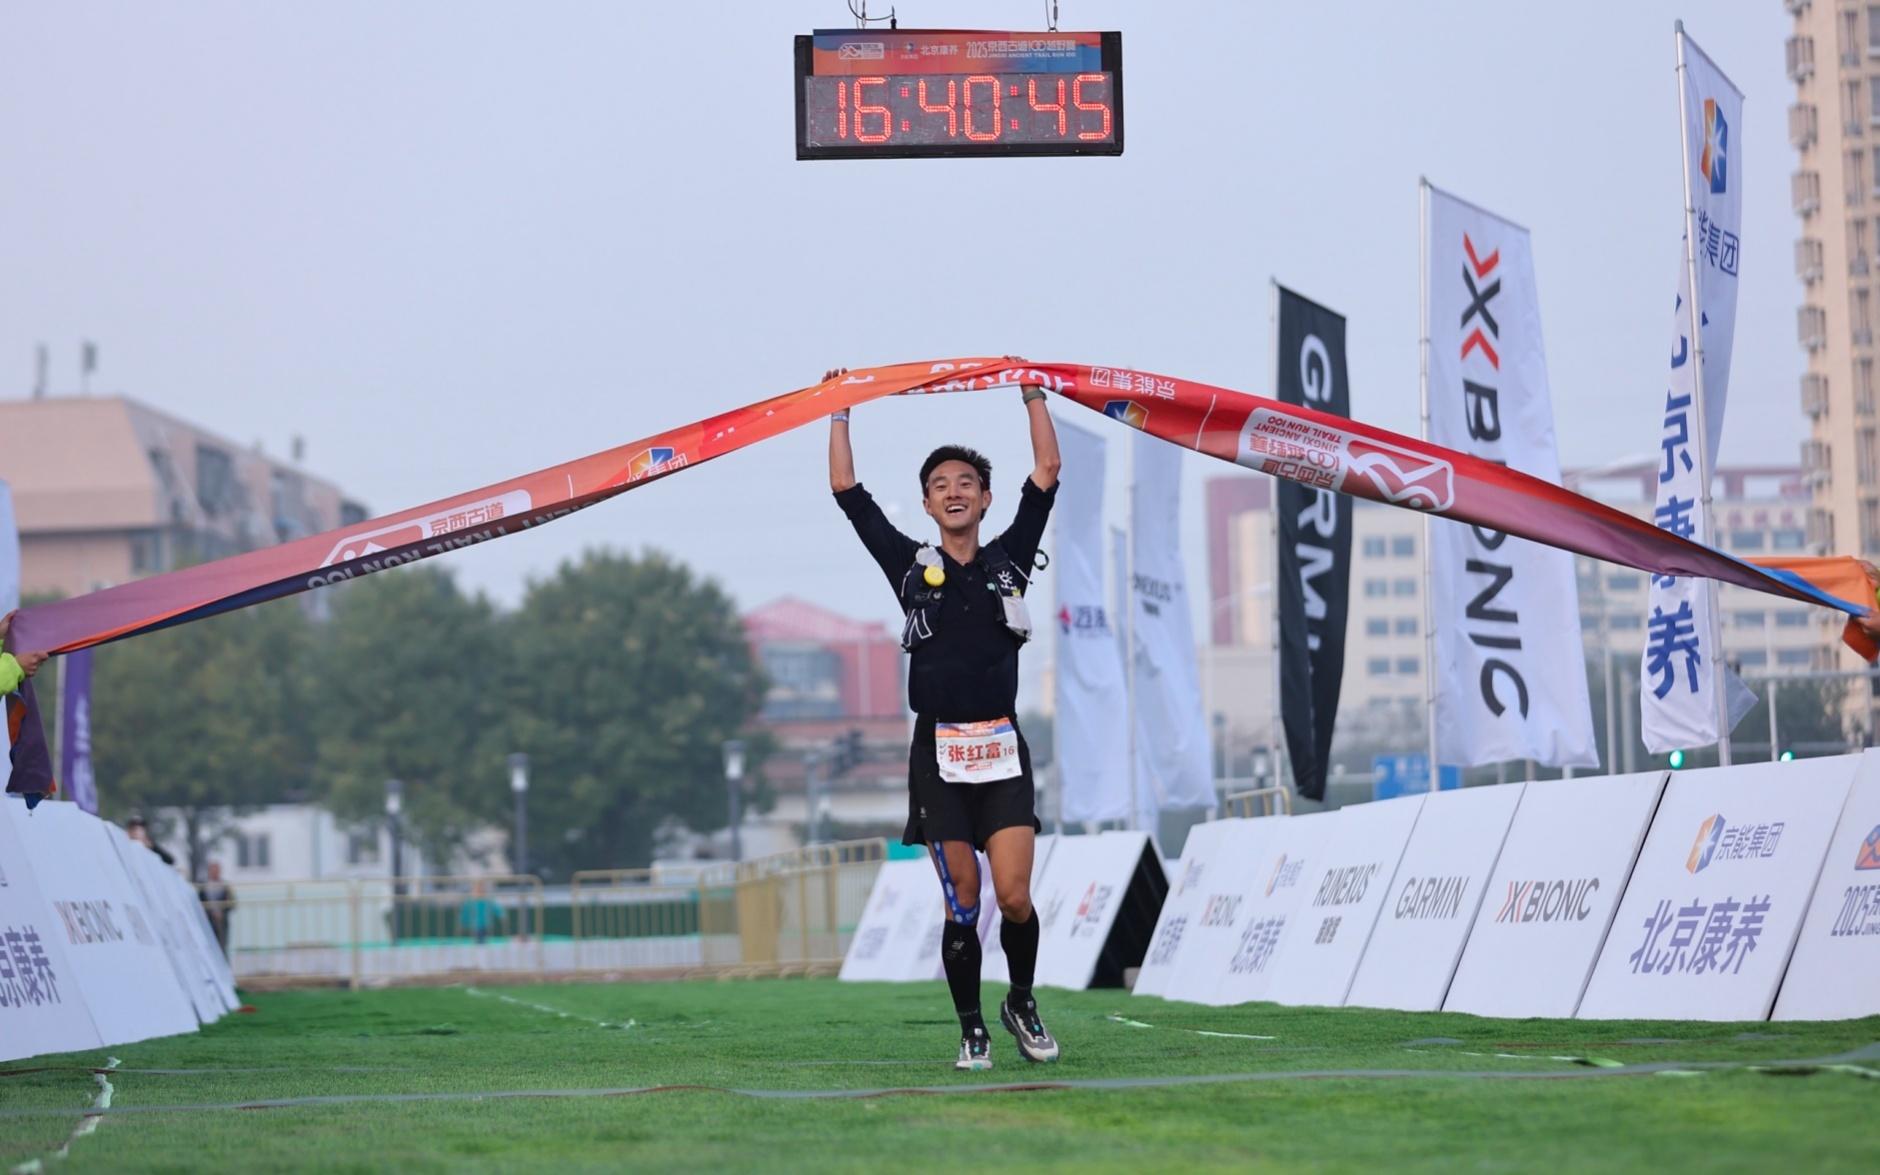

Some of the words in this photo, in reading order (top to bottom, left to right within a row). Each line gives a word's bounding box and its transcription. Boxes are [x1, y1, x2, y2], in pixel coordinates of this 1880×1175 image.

[837, 74, 1110, 142] 16:40:45
[1089, 366, 1176, 399] 京能集团
[1253, 423, 1302, 441] ANCIENT
[1267, 415, 1287, 427] 100
[1287, 420, 1311, 434] RUN
[1302, 436, 1339, 452] JINGXI
[1310, 427, 1342, 443] TRAIL
[1715, 822, 1785, 861] 京能集团
[1394, 875, 1470, 920] GARMIN
[1629, 894, 1771, 976] 北京康养
